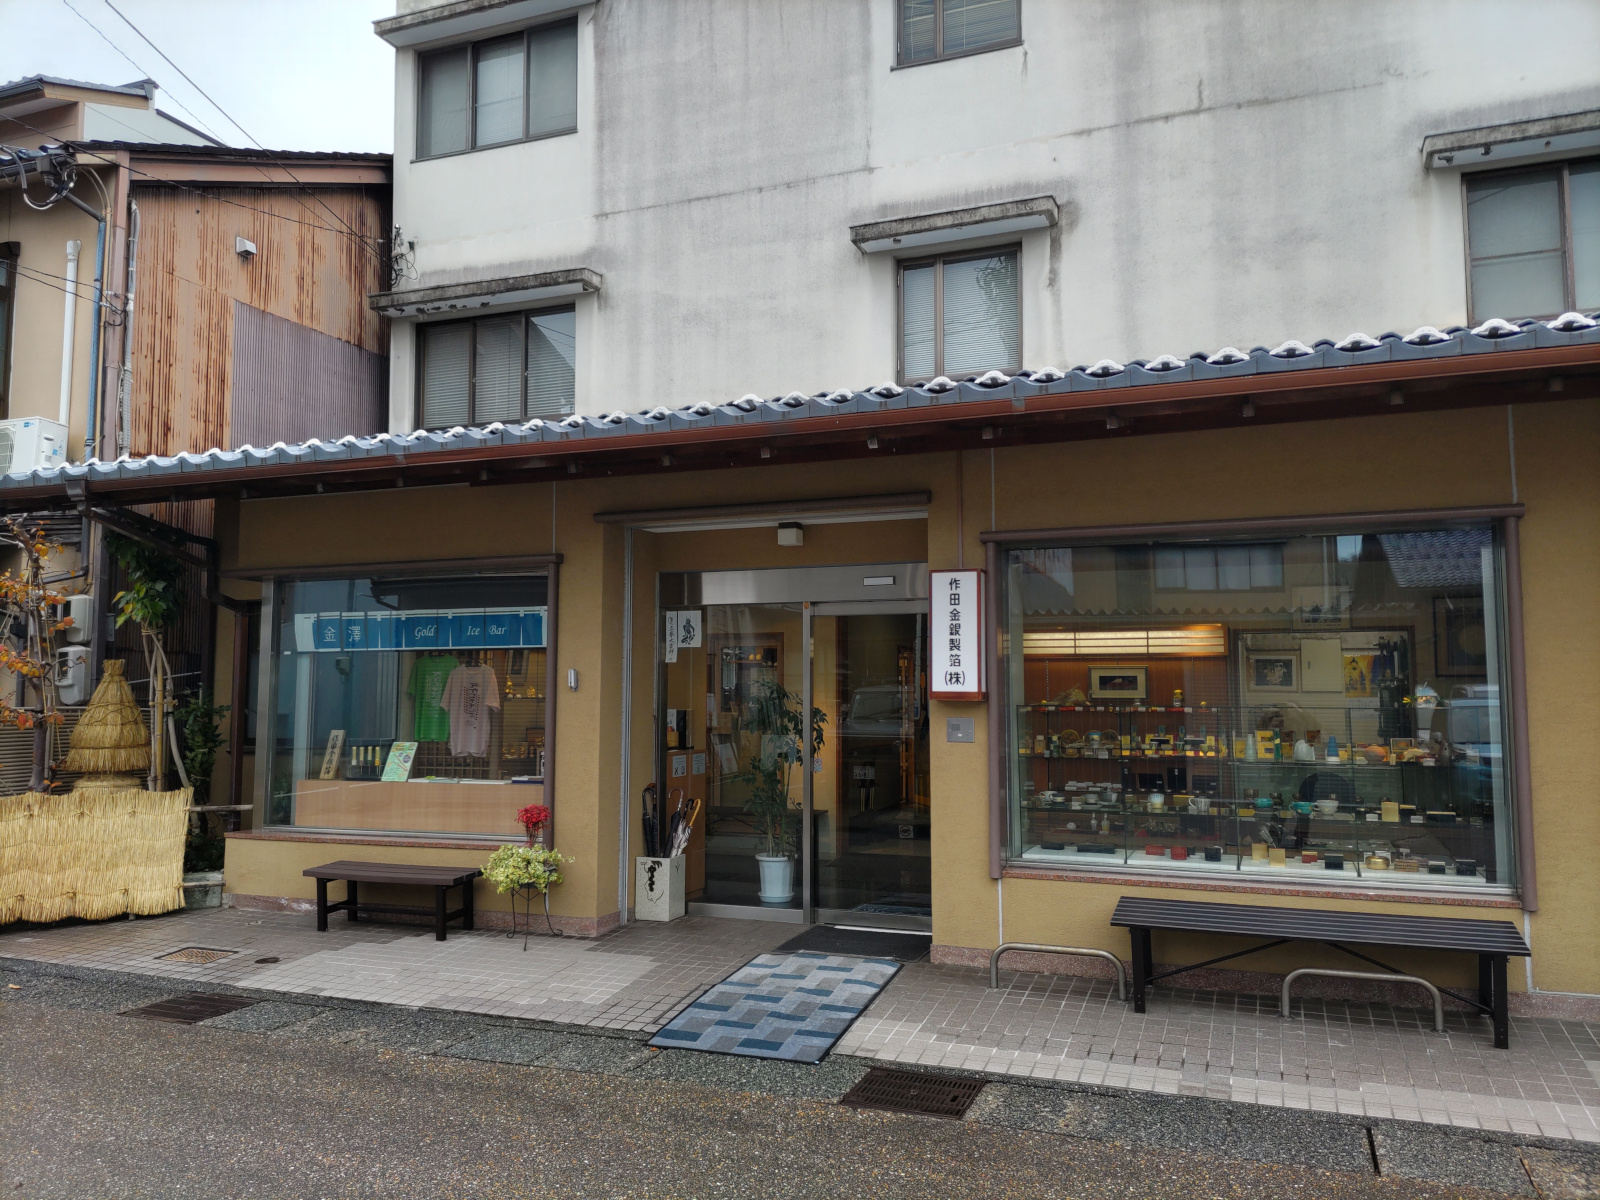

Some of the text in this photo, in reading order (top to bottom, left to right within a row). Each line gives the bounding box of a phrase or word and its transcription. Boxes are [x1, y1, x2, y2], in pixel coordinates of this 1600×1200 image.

[323, 625, 361, 642] 金澤
[414, 624, 507, 640] Gold Ice Bar
